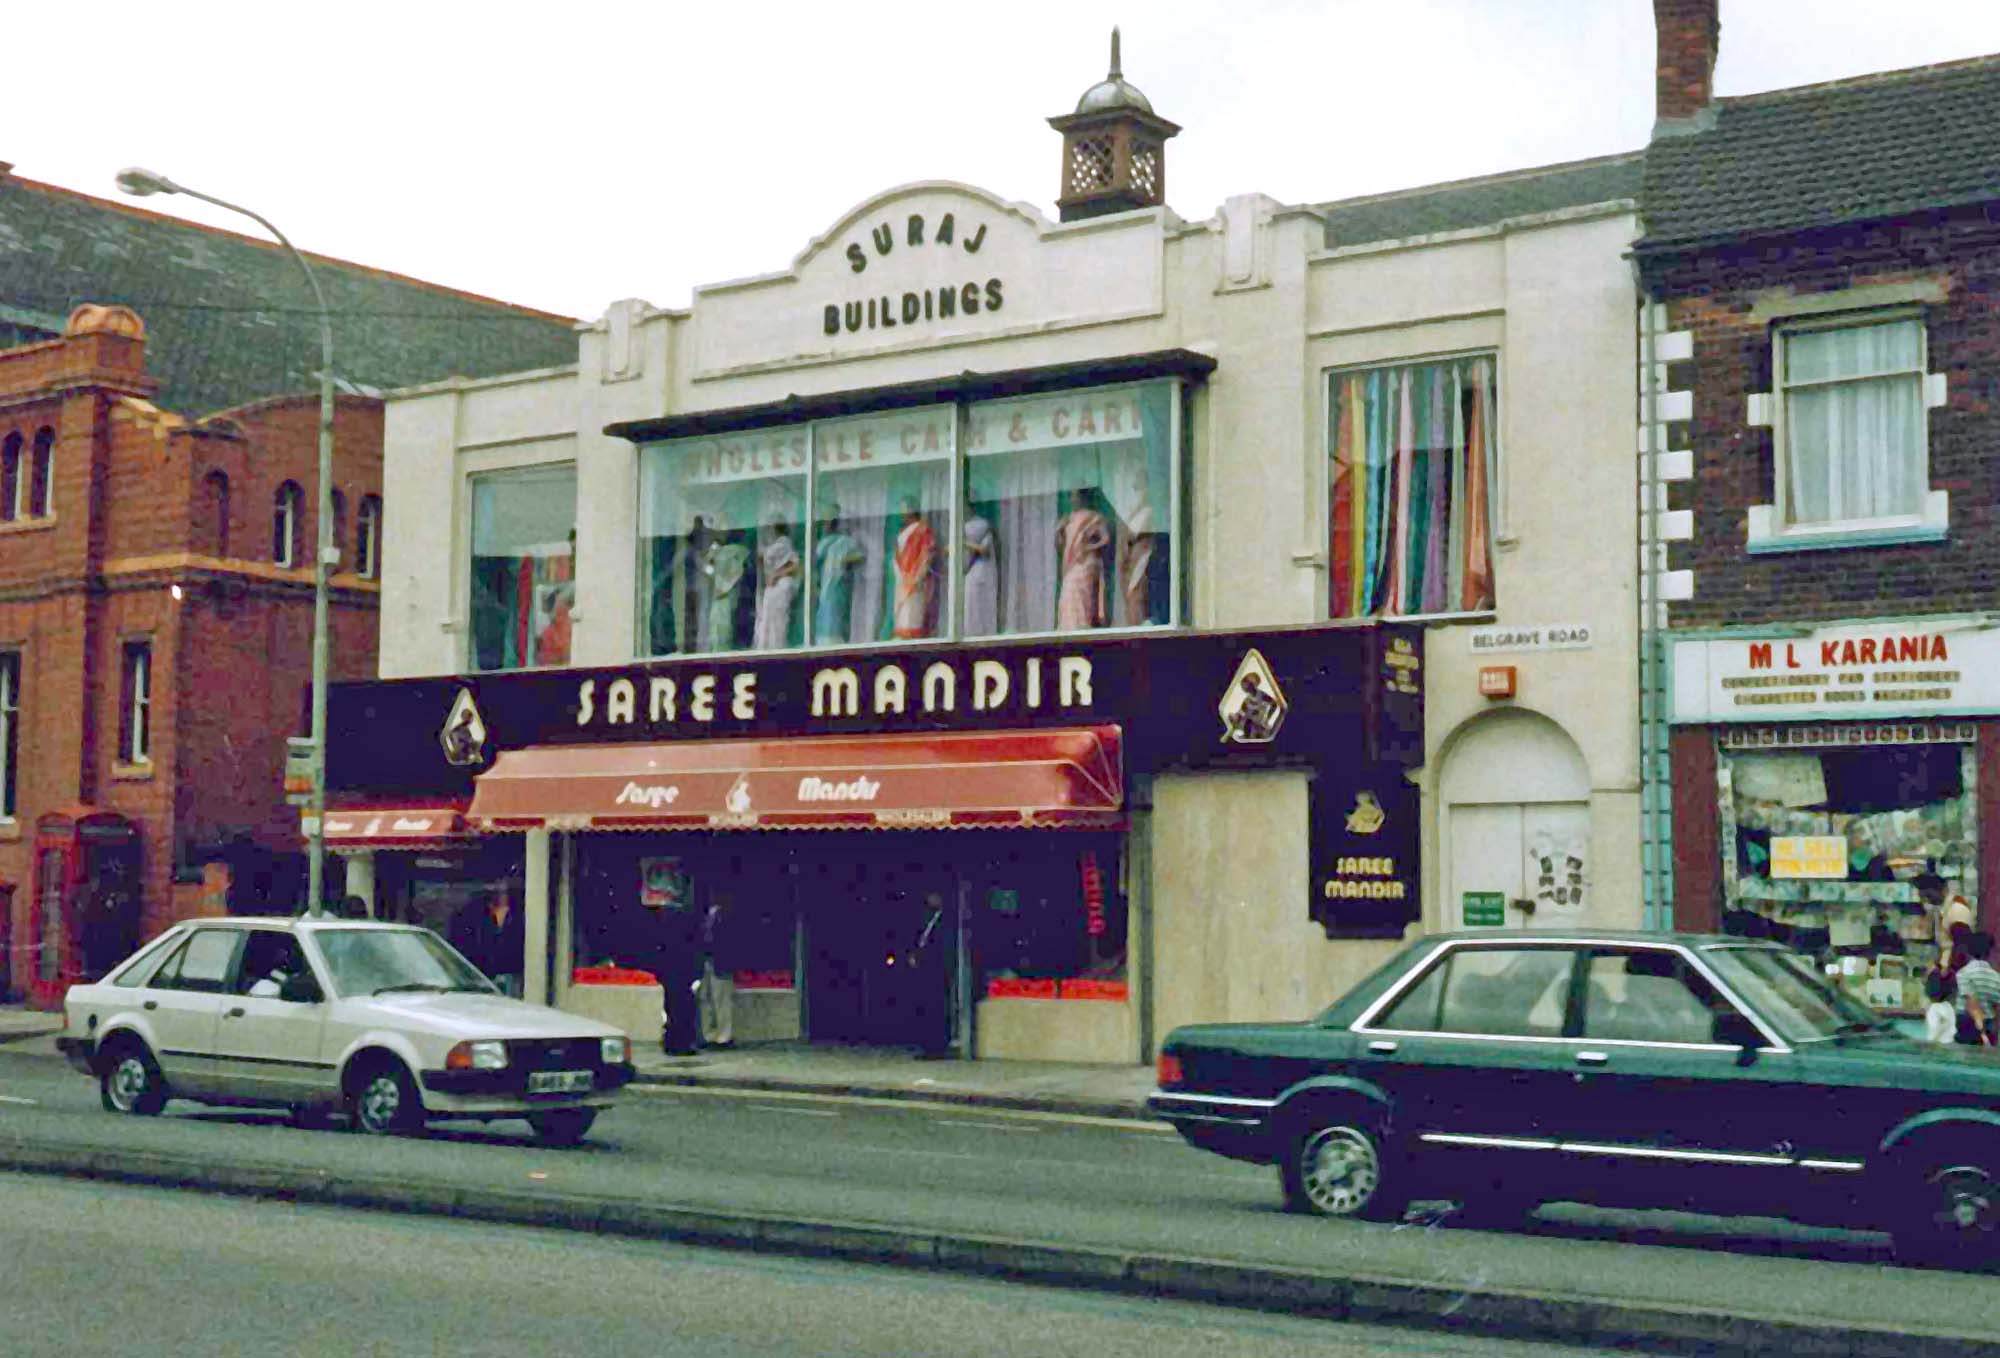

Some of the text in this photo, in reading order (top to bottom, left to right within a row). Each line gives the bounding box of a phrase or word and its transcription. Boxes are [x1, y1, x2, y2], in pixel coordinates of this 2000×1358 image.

[846, 213, 987, 273] SURAJ
[824, 278, 1004, 335] BUILDINGS
[1008, 412, 1028, 443] &
[1473, 628, 1589, 648] BELGRAVE ROAD
[1749, 634, 1948, 669] M L KARANIA
[577, 656, 1094, 727] SAREE MANDIR
[1336, 856, 1394, 875] SAREE
[1324, 880, 1405, 899] MANDIR
